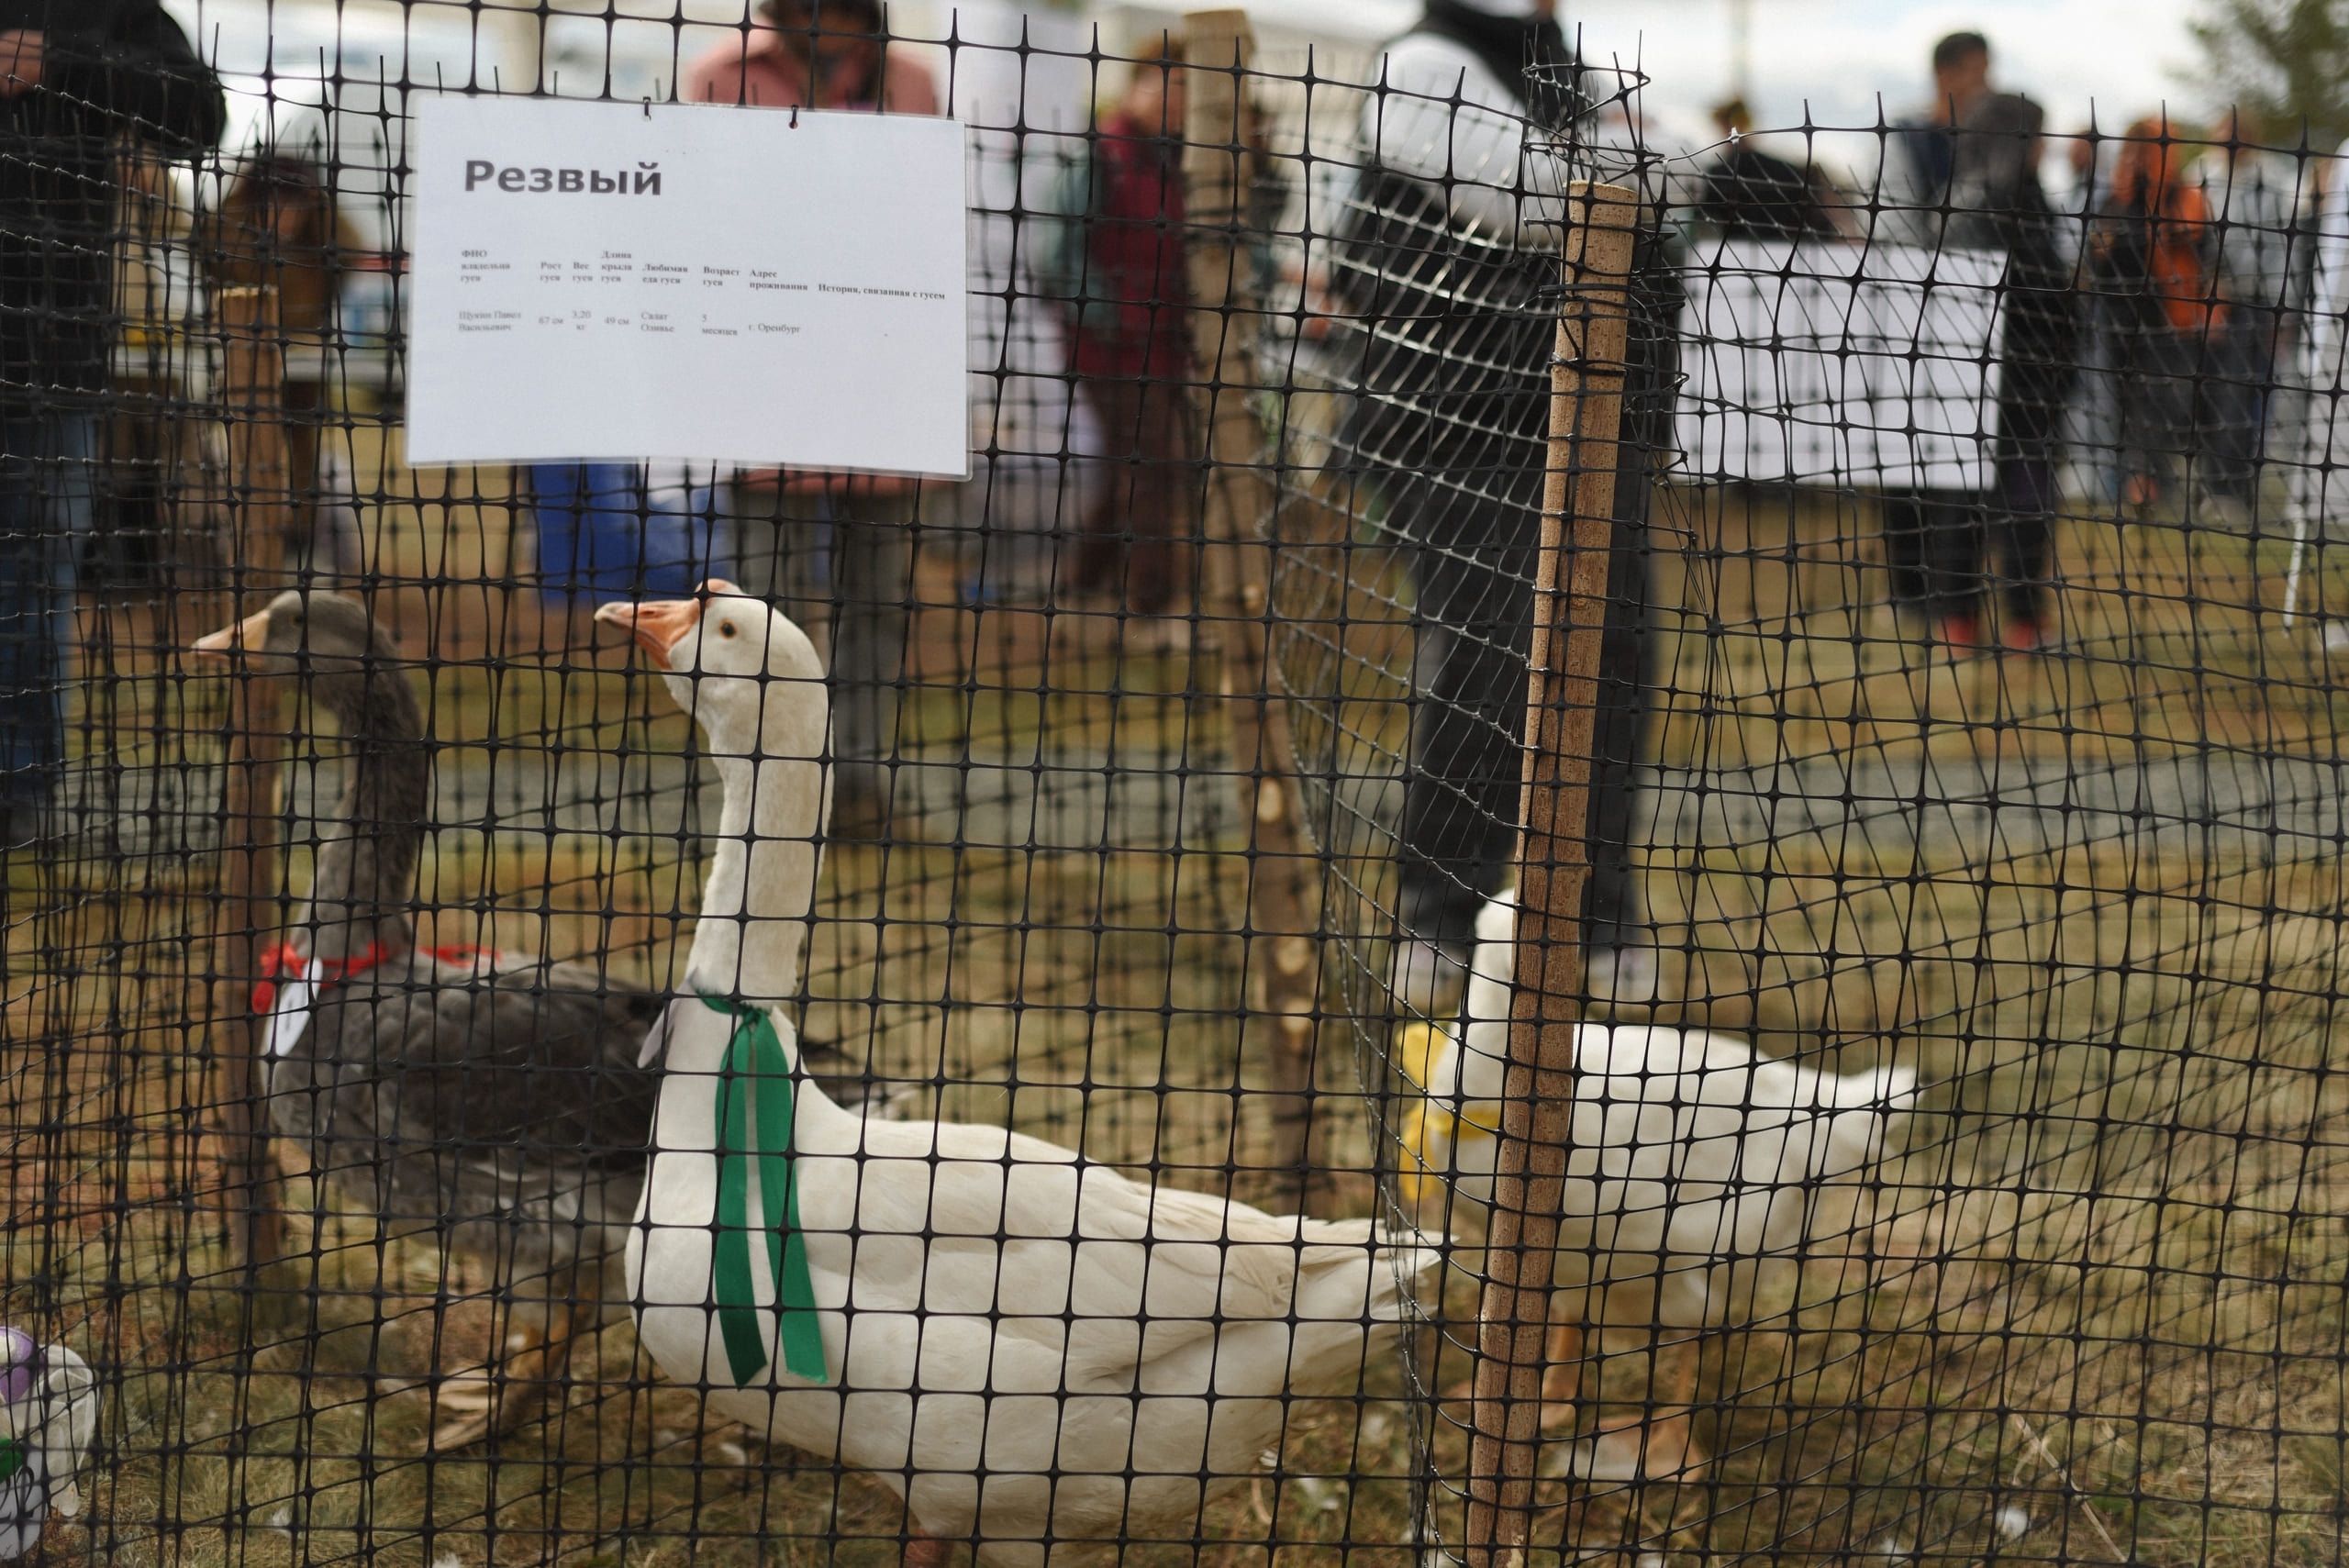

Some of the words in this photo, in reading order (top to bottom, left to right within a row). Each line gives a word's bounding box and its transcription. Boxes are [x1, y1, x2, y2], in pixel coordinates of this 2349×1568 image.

[464, 160, 662, 195] Резвый
[601, 250, 631, 260] Длина
[540, 261, 562, 270] Рост
[573, 261, 590, 270] Вес
[601, 263, 632, 272] крыла
[642, 263, 688, 273] Любимая
[703, 266, 740, 276] Возраст
[750, 269, 778, 279] Адрес
[461, 274, 481, 283] гуся
[540, 274, 561, 283] гуся
[572, 274, 593, 283] гуся
[601, 274, 621, 283] гуся
[642, 276, 658, 284] еда
[661, 277, 681, 285] гуся
[703, 278, 723, 286] гуся
[750, 280, 808, 291] проживания
[818, 283, 861, 295] История,
[863, 288, 910, 297] связанная
[919, 292, 945, 301] гусем
[641, 312, 668, 320] Салат
[758, 323, 801, 335] Оренбург
